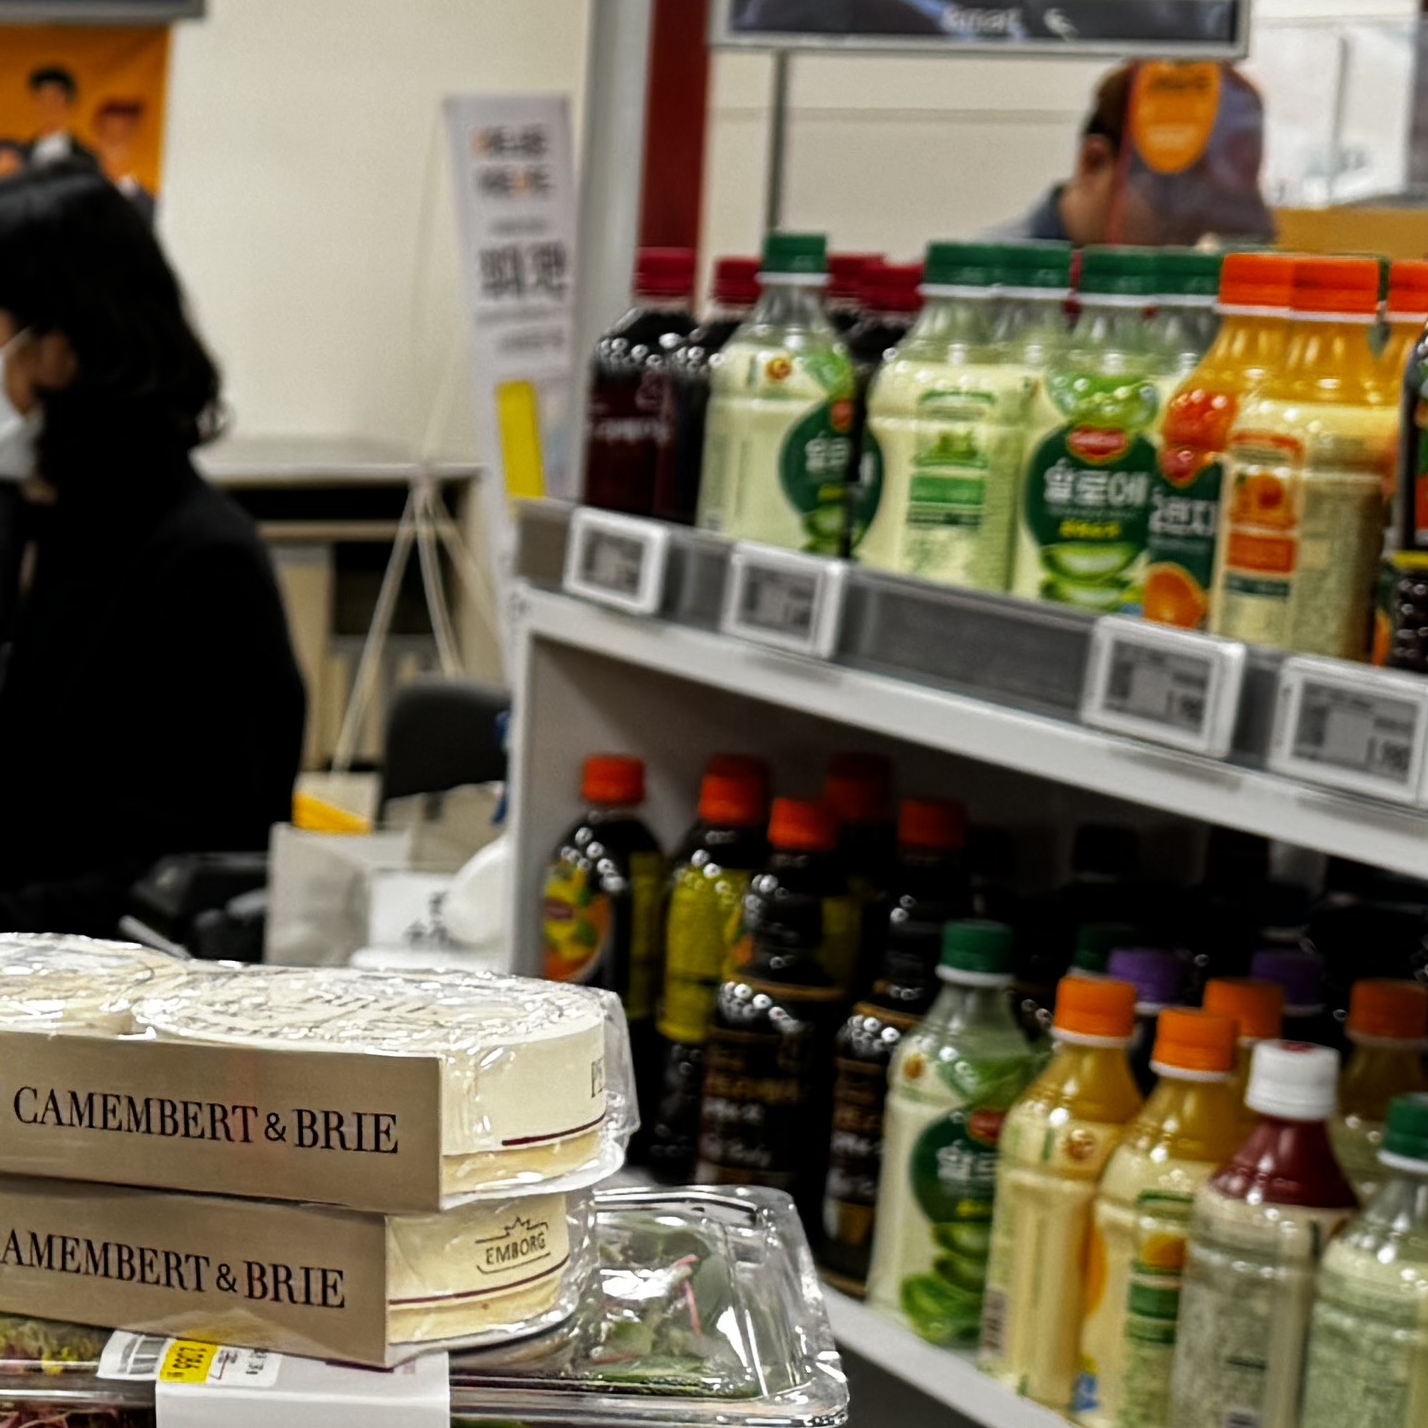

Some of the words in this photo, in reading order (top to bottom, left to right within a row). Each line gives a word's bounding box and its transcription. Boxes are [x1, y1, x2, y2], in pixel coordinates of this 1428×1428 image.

[13, 1086, 258, 1144] CAMEMBERT
[292, 1108, 399, 1155] BRIE
[486, 1231, 547, 1265] EMBORG
[242, 1259, 346, 1309] BRIE
